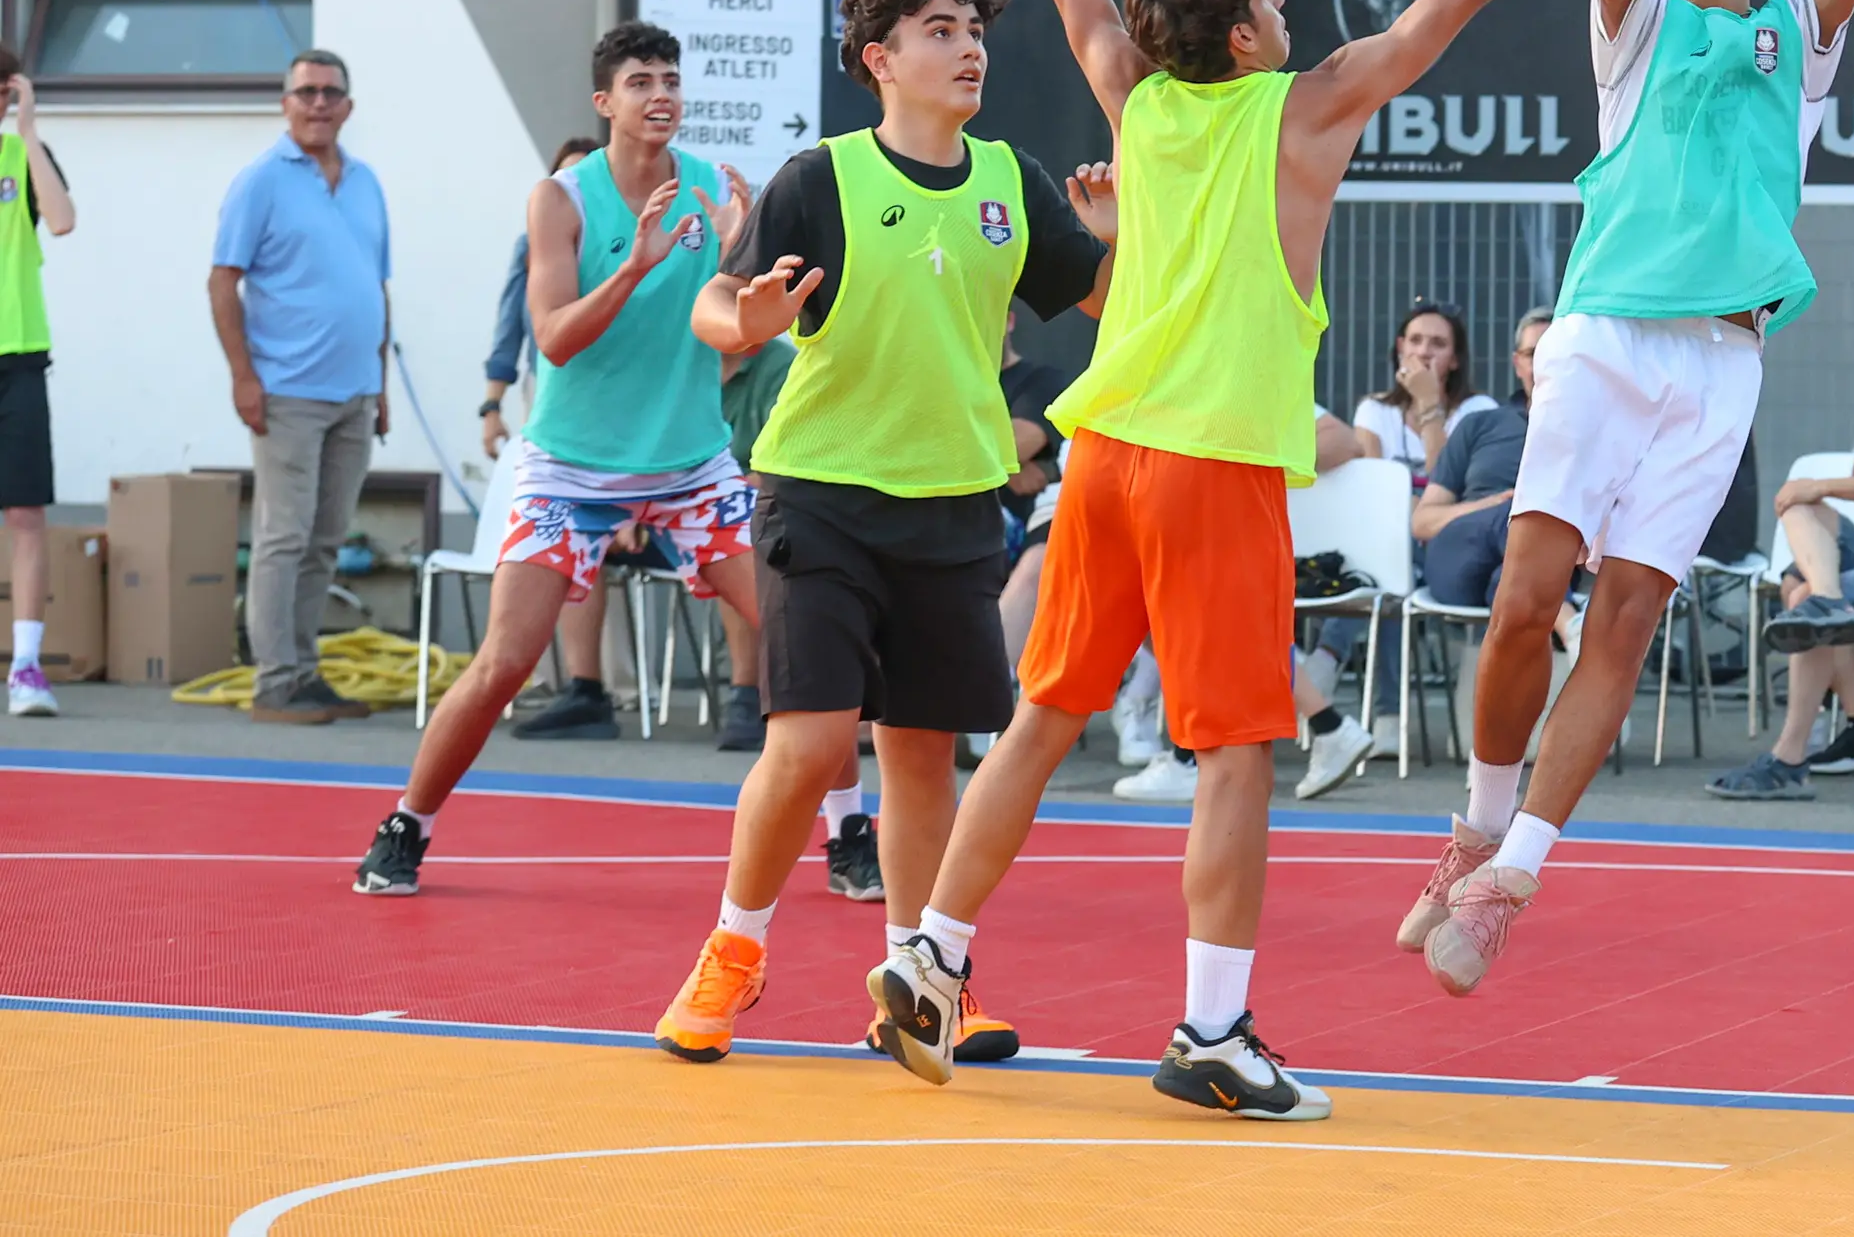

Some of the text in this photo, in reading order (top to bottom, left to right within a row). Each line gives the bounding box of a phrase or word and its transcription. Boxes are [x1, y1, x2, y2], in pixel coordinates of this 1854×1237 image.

[687, 33, 793, 56] INGRESSO
[703, 60, 777, 79] ATLETI
[681, 101, 762, 121] GRESSO
[676, 126, 755, 145] RIBUNE
[1360, 94, 1571, 156] IBULL
[928, 247, 943, 275] 1
